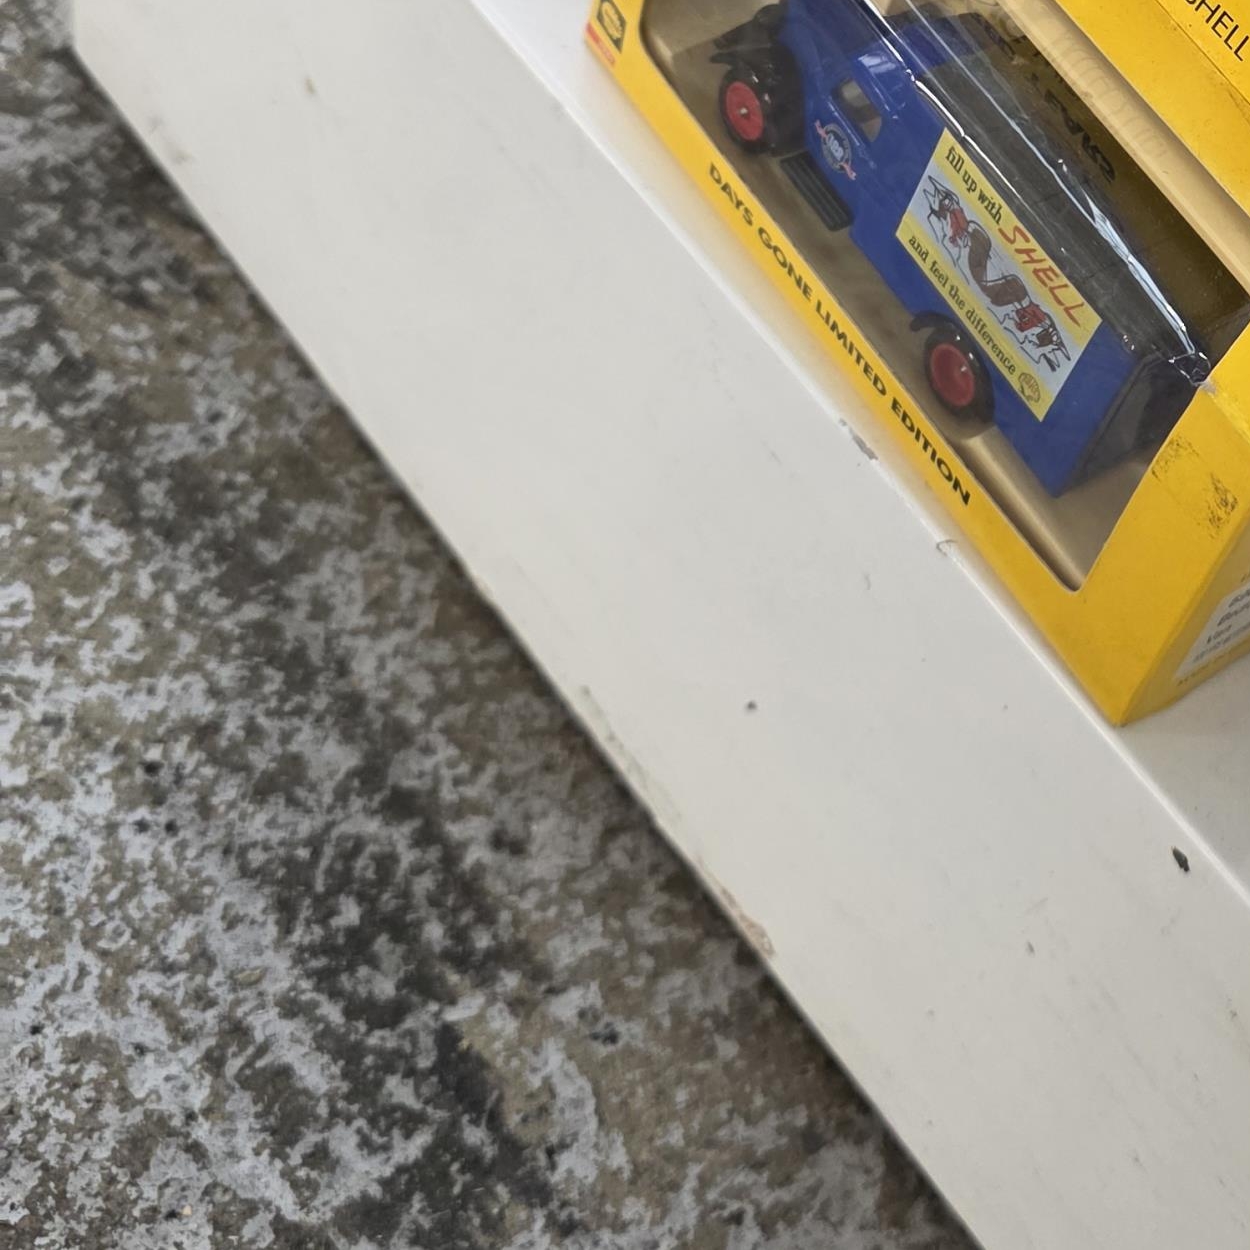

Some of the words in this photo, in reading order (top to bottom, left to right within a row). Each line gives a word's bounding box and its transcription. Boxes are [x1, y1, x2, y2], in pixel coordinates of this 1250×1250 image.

[908, 235, 929, 264] and
[929, 257, 949, 287] feel
[948, 283, 966, 311] the
[964, 300, 1017, 376] difference
[945, 146, 964, 175] fill
[964, 173, 981, 196] up
[977, 185, 1003, 225] with
[1001, 225, 1085, 327] SHELL
[708, 162, 753, 227] DAYS
[757, 226, 813, 301] GONE
[814, 302, 887, 397] LIMITED
[890, 397, 971, 507] EDITION
